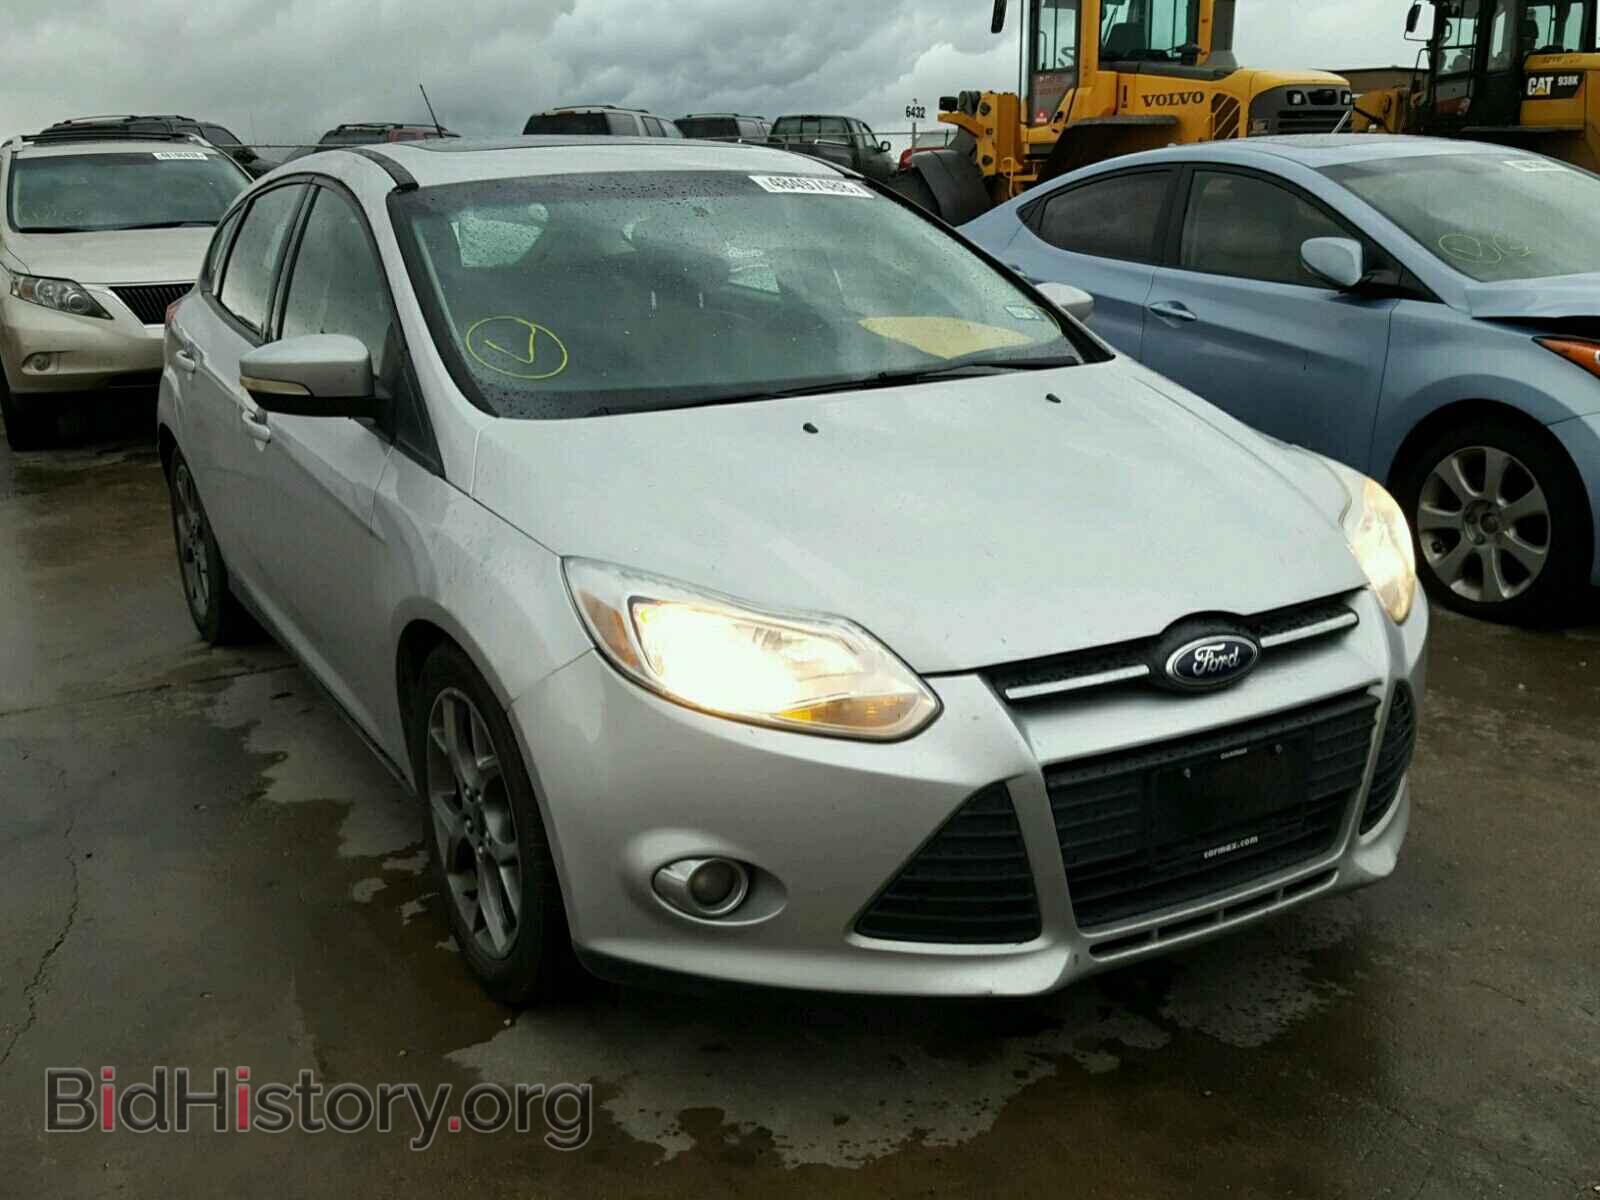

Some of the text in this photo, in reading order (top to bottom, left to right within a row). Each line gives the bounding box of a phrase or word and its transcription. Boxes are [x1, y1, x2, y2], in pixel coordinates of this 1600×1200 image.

[1527, 76, 1554, 95] CAT
[1141, 91, 1205, 107] VOLVO
[905, 105, 926, 119] 6432
[1192, 643, 1240, 676] Ford
